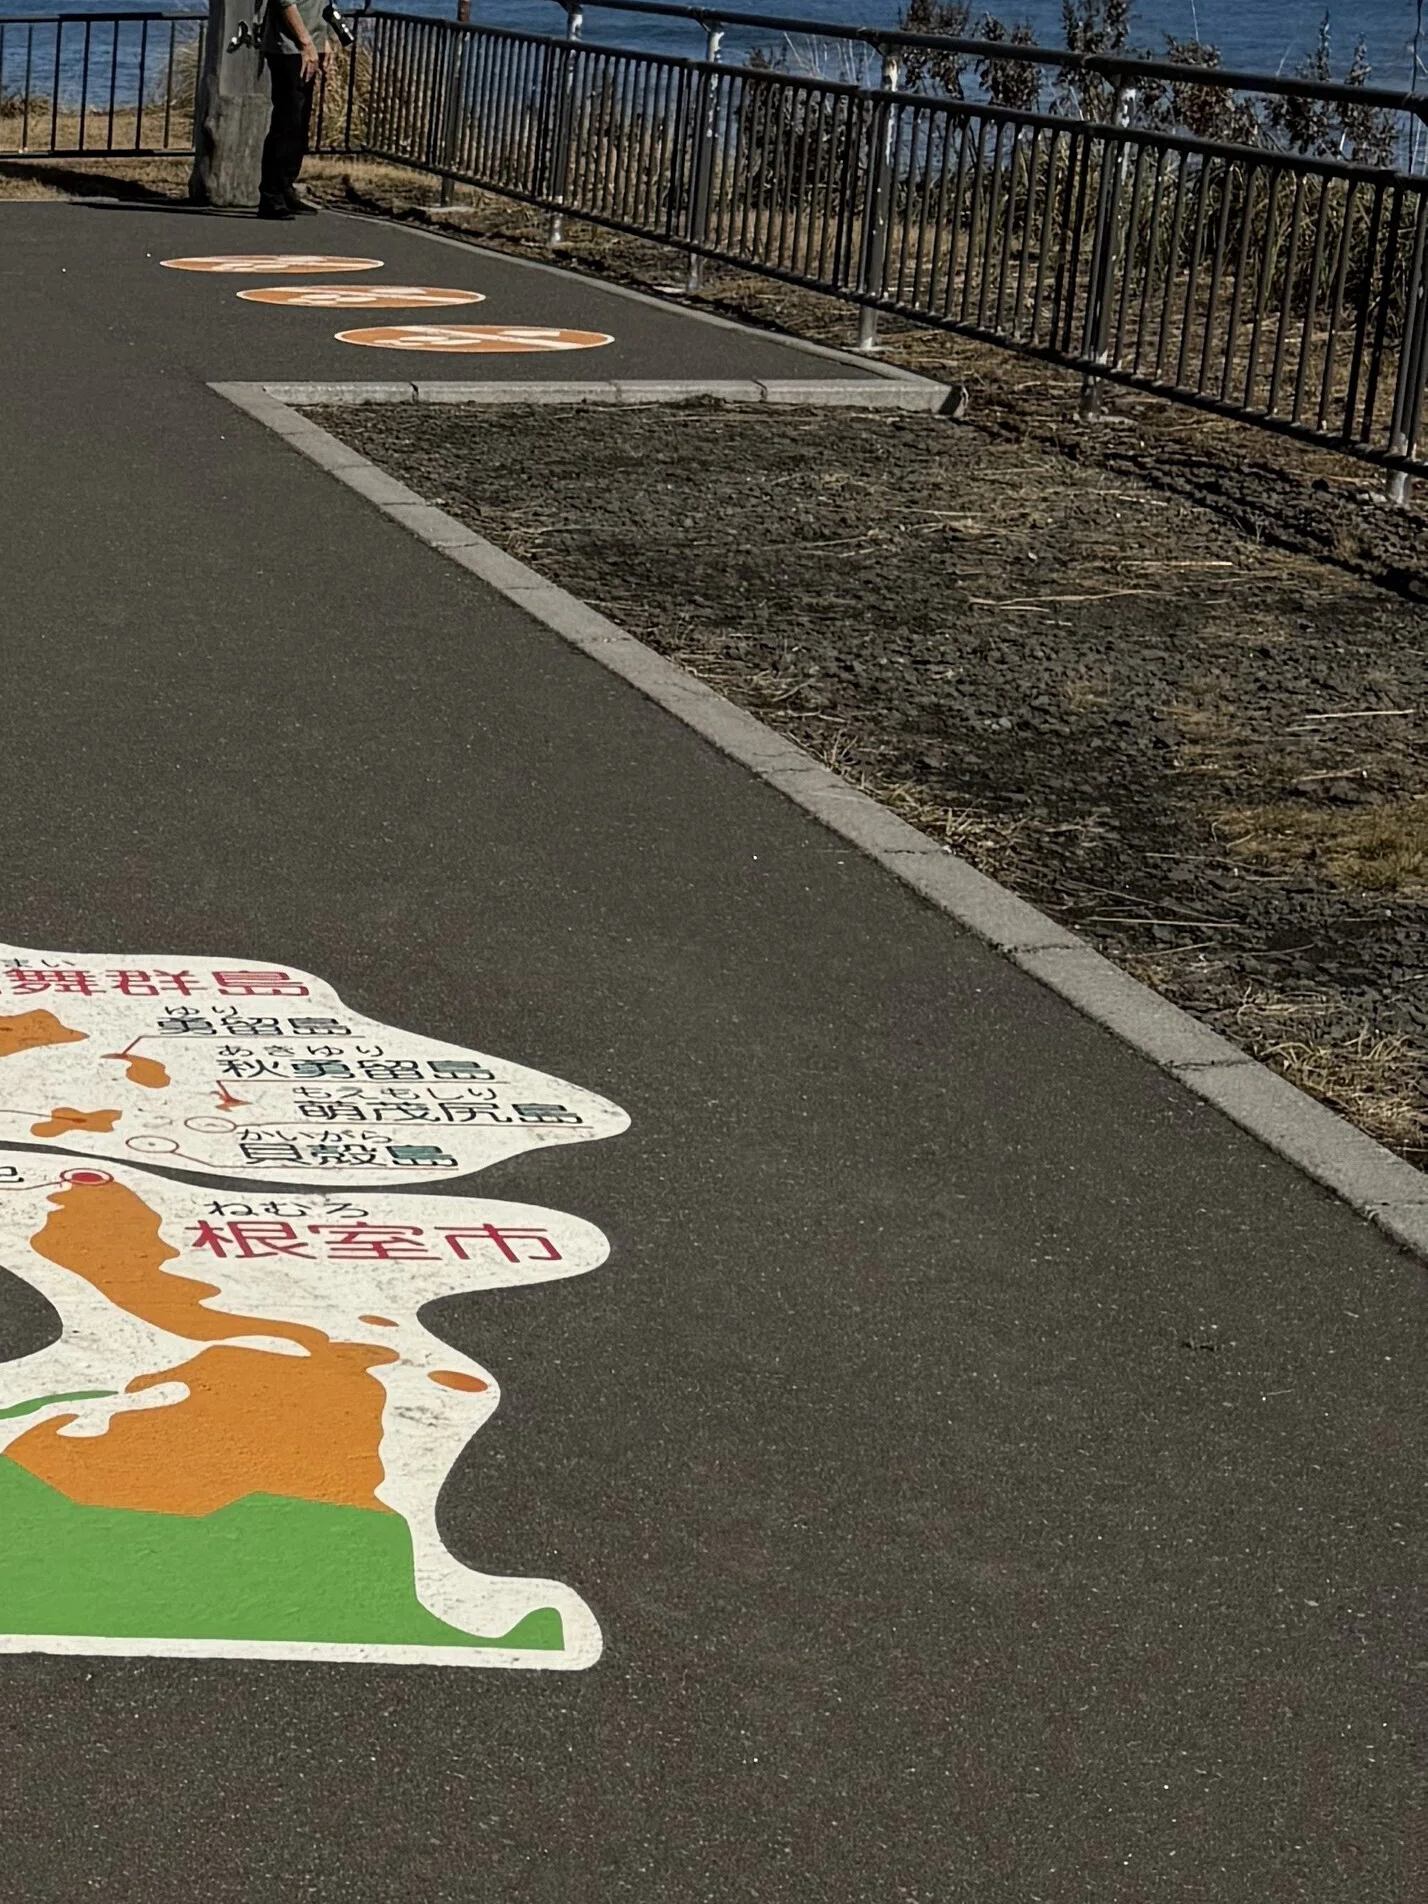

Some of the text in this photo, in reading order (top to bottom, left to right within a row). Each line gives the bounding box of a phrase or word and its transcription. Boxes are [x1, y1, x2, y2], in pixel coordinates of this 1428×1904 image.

[164, 1006, 238, 1019] ゆり
[157, 1017, 352, 1035] 勇留島
[217, 1059, 495, 1081] 秋勇留島
[293, 1086, 498, 1101] もえもしり
[294, 1100, 584, 1124] 萌茂尻島
[237, 1129, 392, 1144] かいがら
[239, 1142, 459, 1167] 貝殻島
[203, 1200, 370, 1218] ねむろ
[184, 1220, 564, 1263] 根室市
